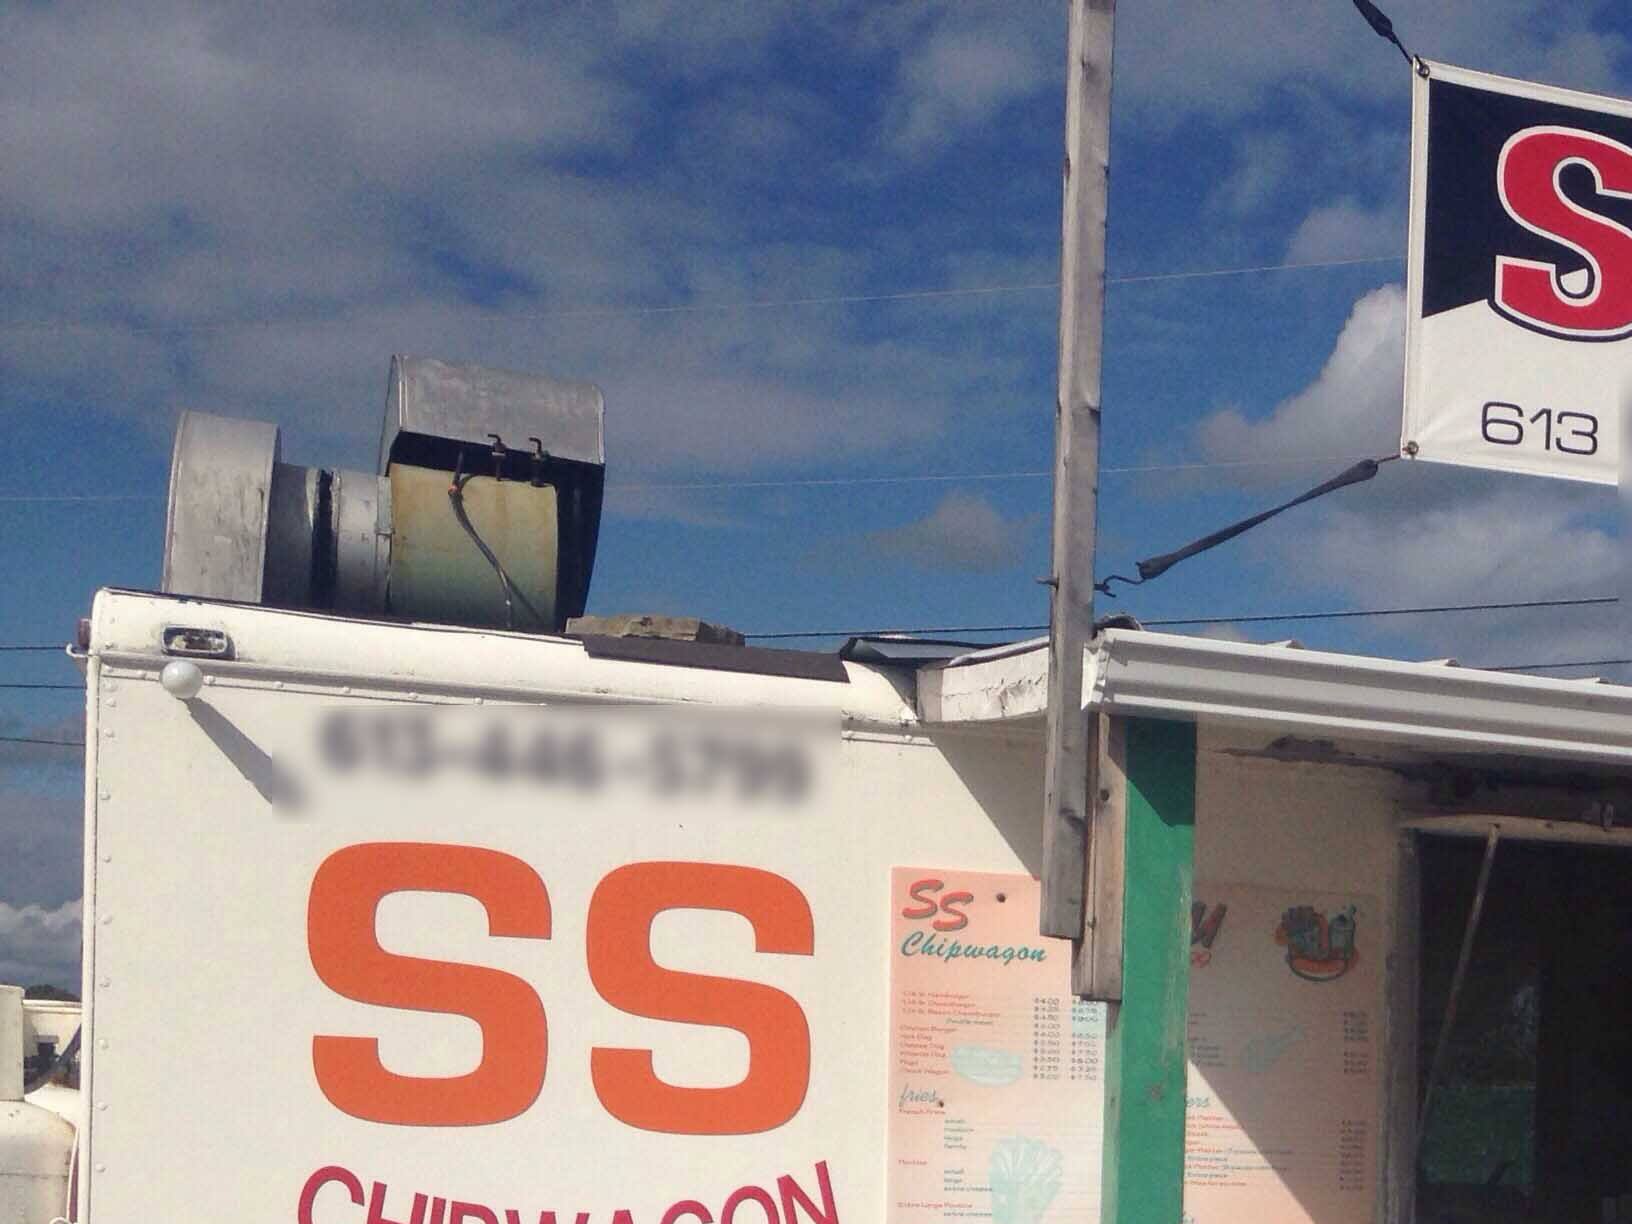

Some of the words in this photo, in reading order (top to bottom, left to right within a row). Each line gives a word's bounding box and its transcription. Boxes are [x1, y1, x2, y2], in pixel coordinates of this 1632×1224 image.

[1481, 401, 1599, 455] 613
[902, 879, 974, 932] SS
[901, 931, 1047, 966] Chipwagon
[306, 841, 816, 1136] SS
